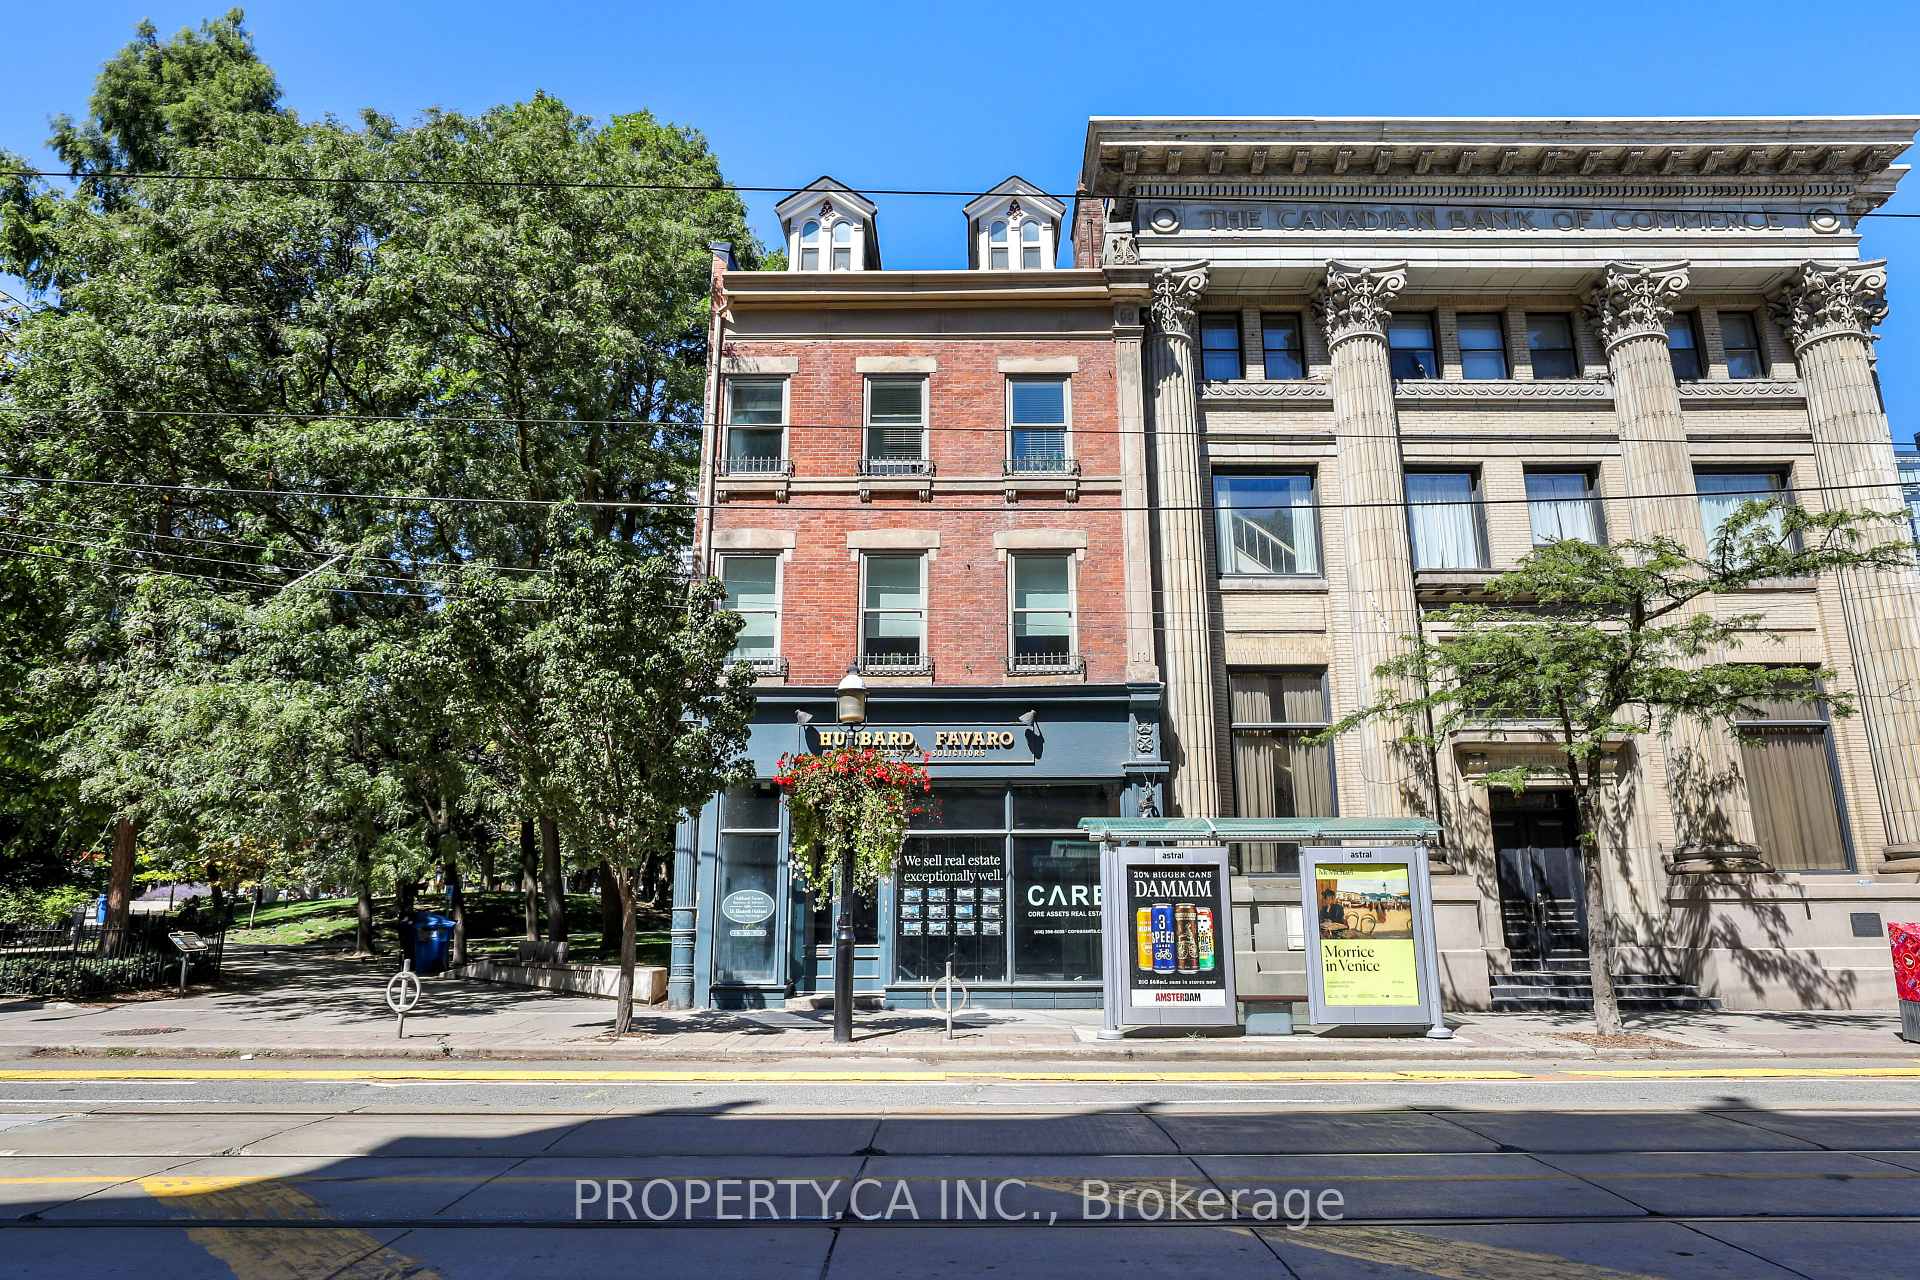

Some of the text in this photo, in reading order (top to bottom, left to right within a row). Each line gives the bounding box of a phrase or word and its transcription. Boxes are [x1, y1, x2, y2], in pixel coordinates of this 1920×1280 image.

[1206, 208, 1785, 232] THE CANADIAN BANK OF COMMERCE
[819, 731, 1015, 746] HUBARD FAVARO
[931, 749, 986, 757] SOLICITORS
[904, 854, 1000, 866] We sell real estate
[904, 869, 1004, 883] exceptionally well.
[1135, 880, 1212, 897] DAMMM
[1158, 914, 1166, 930] 3
[1324, 945, 1375, 958] Morrice
[1326, 959, 1380, 972] in Venice
[1155, 992, 1201, 1002] AMSTERDAM
